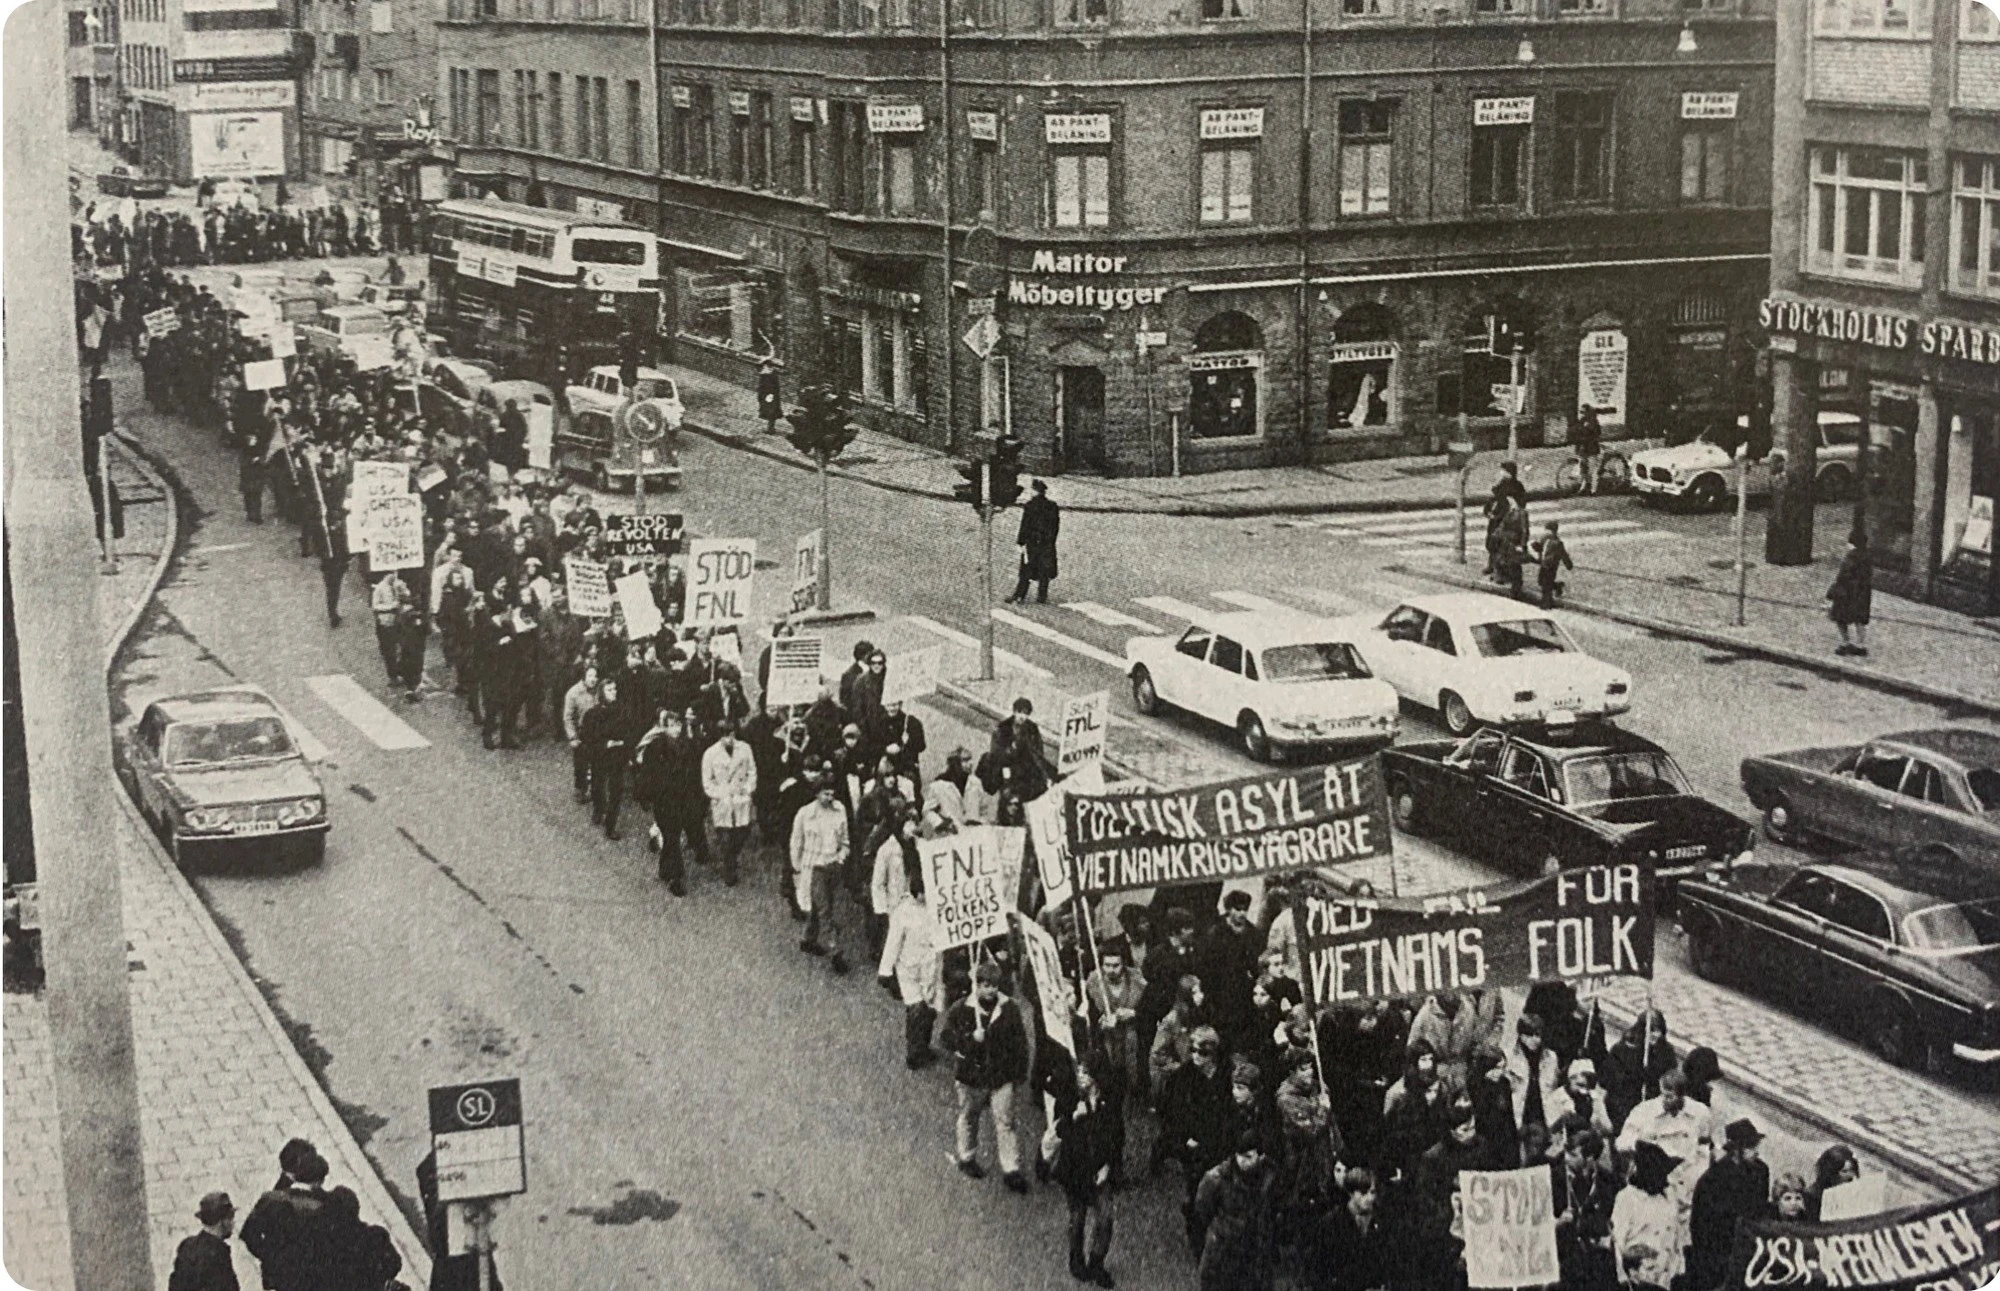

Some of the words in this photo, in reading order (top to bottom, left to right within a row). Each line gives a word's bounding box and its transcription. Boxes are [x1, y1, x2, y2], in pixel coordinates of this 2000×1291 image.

[1051, 118, 1065, 126] AB
[1208, 113, 1221, 121] AB
[1031, 250, 1127, 273] Mattor
[1007, 280, 1167, 310] Möbeltyger
[1758, 298, 1908, 348] STOCKHOLMS
[607, 527, 683, 542] REVOLTEN
[626, 542, 655, 555] USA
[697, 545, 752, 585] STÖD
[695, 590, 744, 620] FNL
[1076, 795, 1207, 843] POLITISK
[1215, 776, 1315, 837] ASYL
[1323, 762, 1364, 810] ÅT
[932, 844, 998, 886] FNL
[1076, 815, 1375, 891] VIETNAMKRIGSVÄGRARE
[937, 878, 996, 907] SEGER
[937, 895, 1000, 925] FOLKENS
[947, 915, 997, 943] HOPP
[1309, 928, 1487, 1004] VIETNAMS
[1528, 915, 1639, 979] FOLK
[464, 1096, 488, 1118] SL
